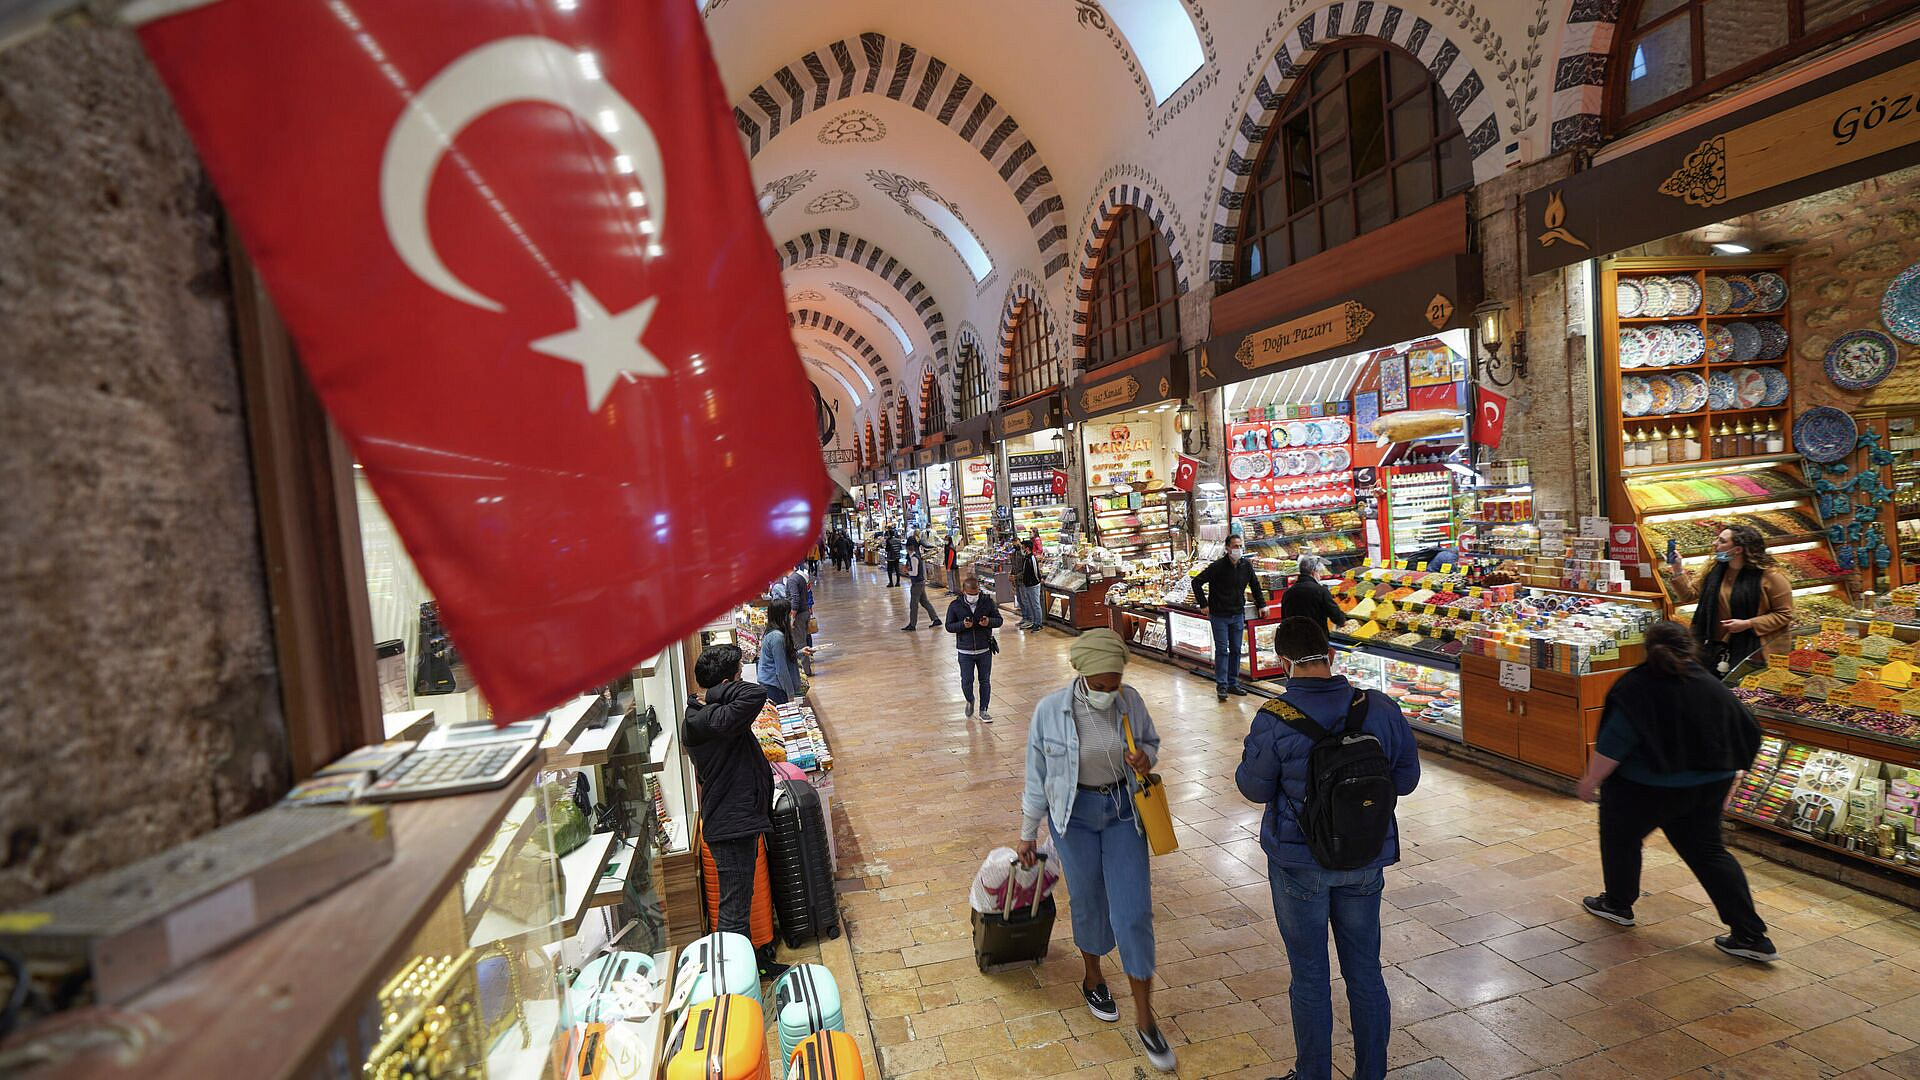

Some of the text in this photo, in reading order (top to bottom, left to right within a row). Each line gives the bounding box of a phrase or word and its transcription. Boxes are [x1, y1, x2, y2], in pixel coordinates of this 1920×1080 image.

[1833, 94, 1920, 146] Göz
[1432, 304, 1445, 320] 21
[1263, 322, 1333, 353] Doğu Pazarı
[1088, 439, 1152, 454] KANAAT
